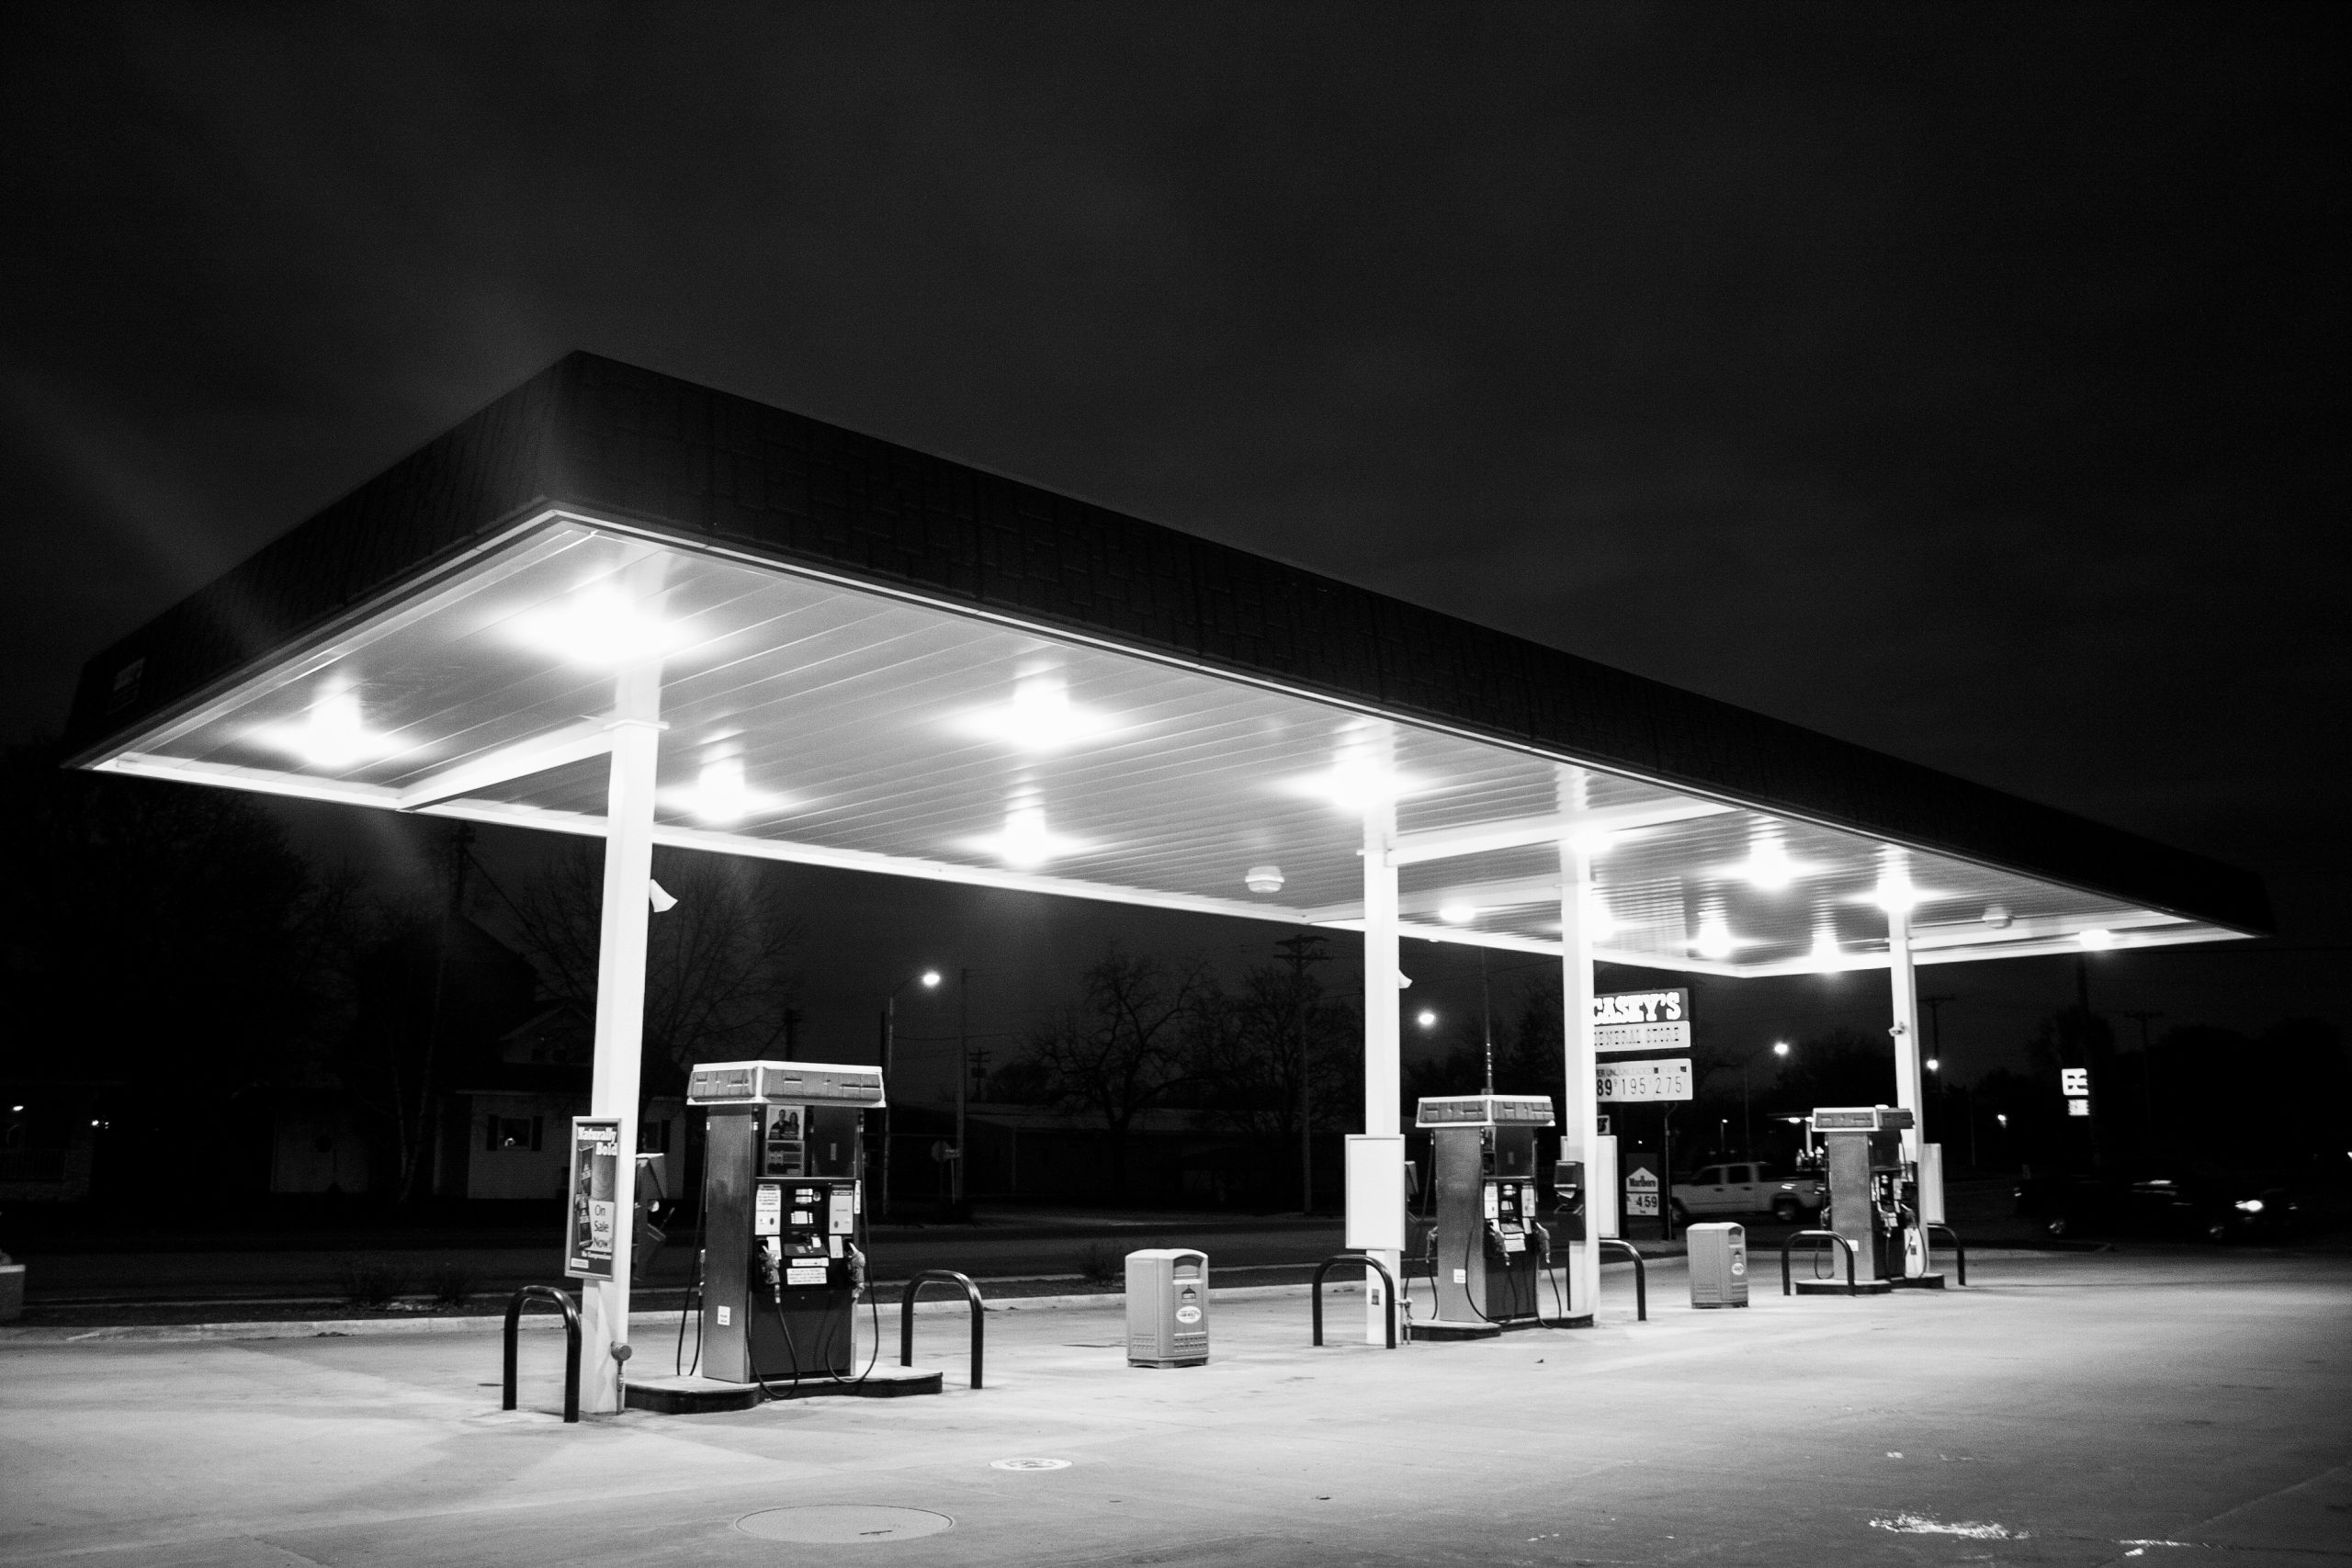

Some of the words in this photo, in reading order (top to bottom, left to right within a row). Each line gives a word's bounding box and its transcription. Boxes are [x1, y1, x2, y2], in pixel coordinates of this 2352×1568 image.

[1594, 992, 1681, 1025] CASEY'S
[1622, 1077, 1646, 1095] 195
[1655, 1076, 1682, 1093] 275
[578, 1126, 616, 1145] Naturally
[595, 1141, 617, 1156] Bold
[1636, 1196, 1657, 1207] 459
[595, 1205, 606, 1216] On
[594, 1221, 609, 1233] Sale
